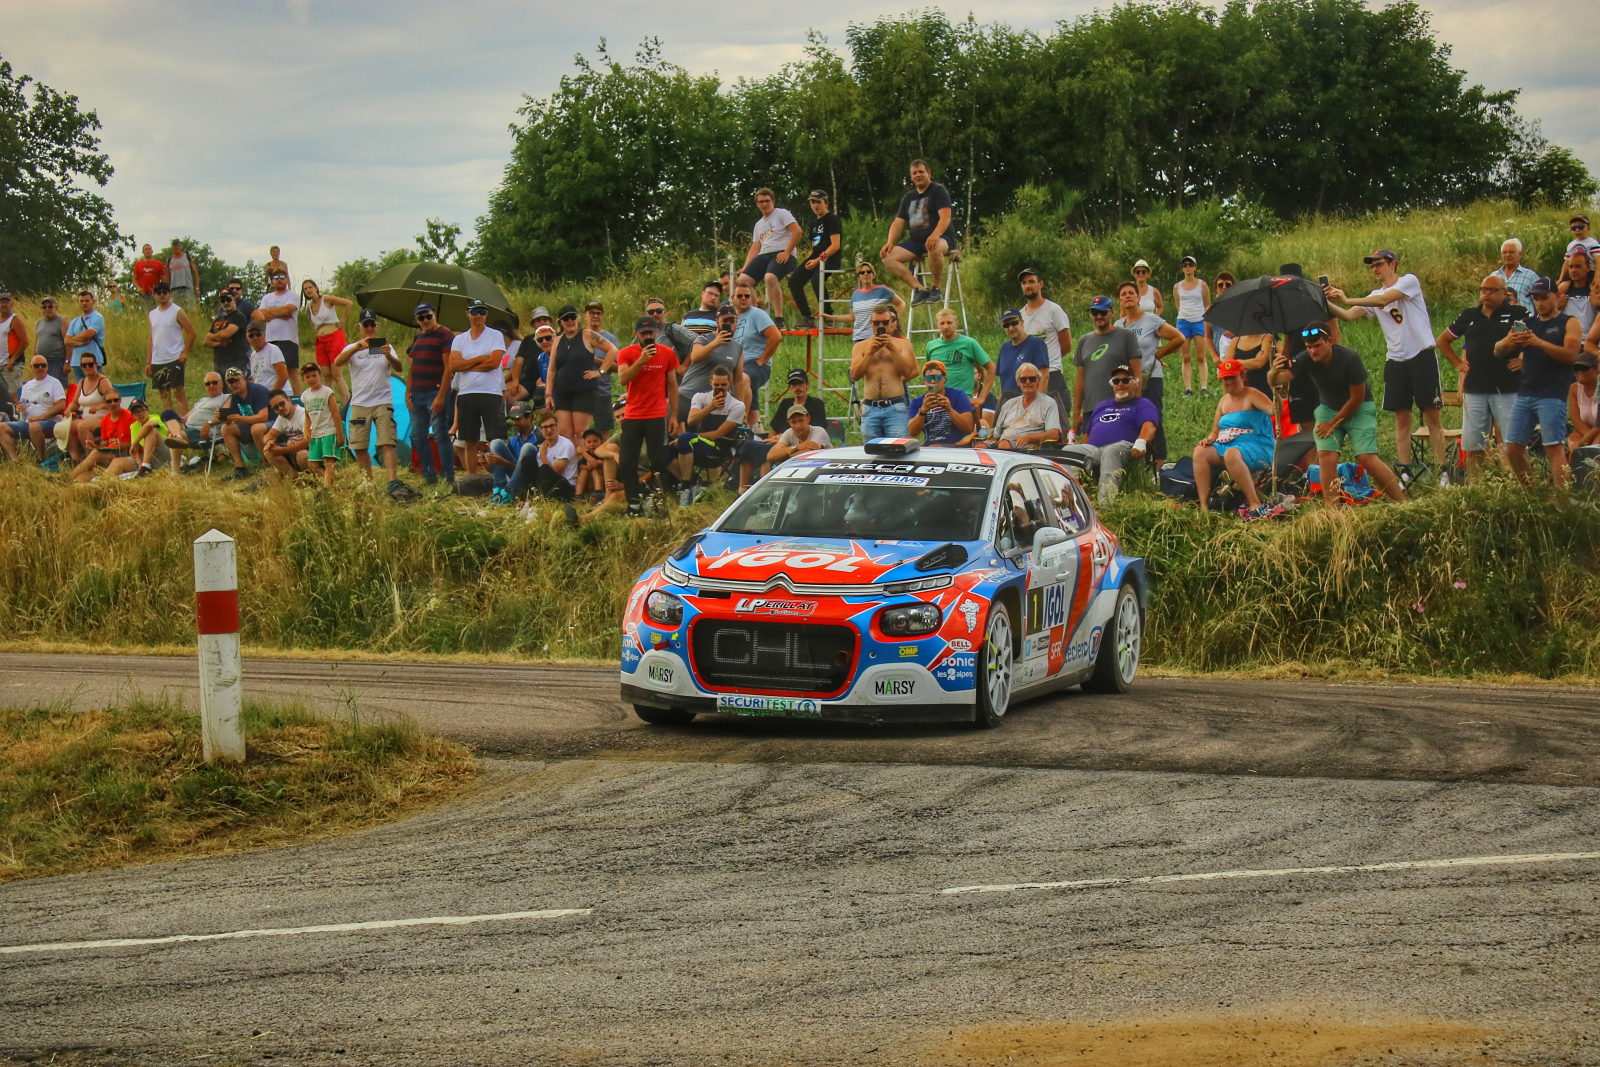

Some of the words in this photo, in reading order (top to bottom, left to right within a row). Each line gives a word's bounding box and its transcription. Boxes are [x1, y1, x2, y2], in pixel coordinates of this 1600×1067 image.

[1390, 308, 1404, 325] 6
[786, 469, 799, 478] 1
[822, 462, 915, 471] ORECA
[872, 475, 926, 484] TEAMS
[707, 552, 866, 572] IGOL
[1033, 594, 1038, 629] 1
[1043, 584, 1065, 629] IGOL
[714, 629, 831, 669] CHL
[951, 640, 970, 648] BELL
[1050, 640, 1062, 660] SFR
[649, 665, 674, 683] MARSY
[875, 680, 916, 695] MARSY
[720, 696, 796, 710] SECURITEST
